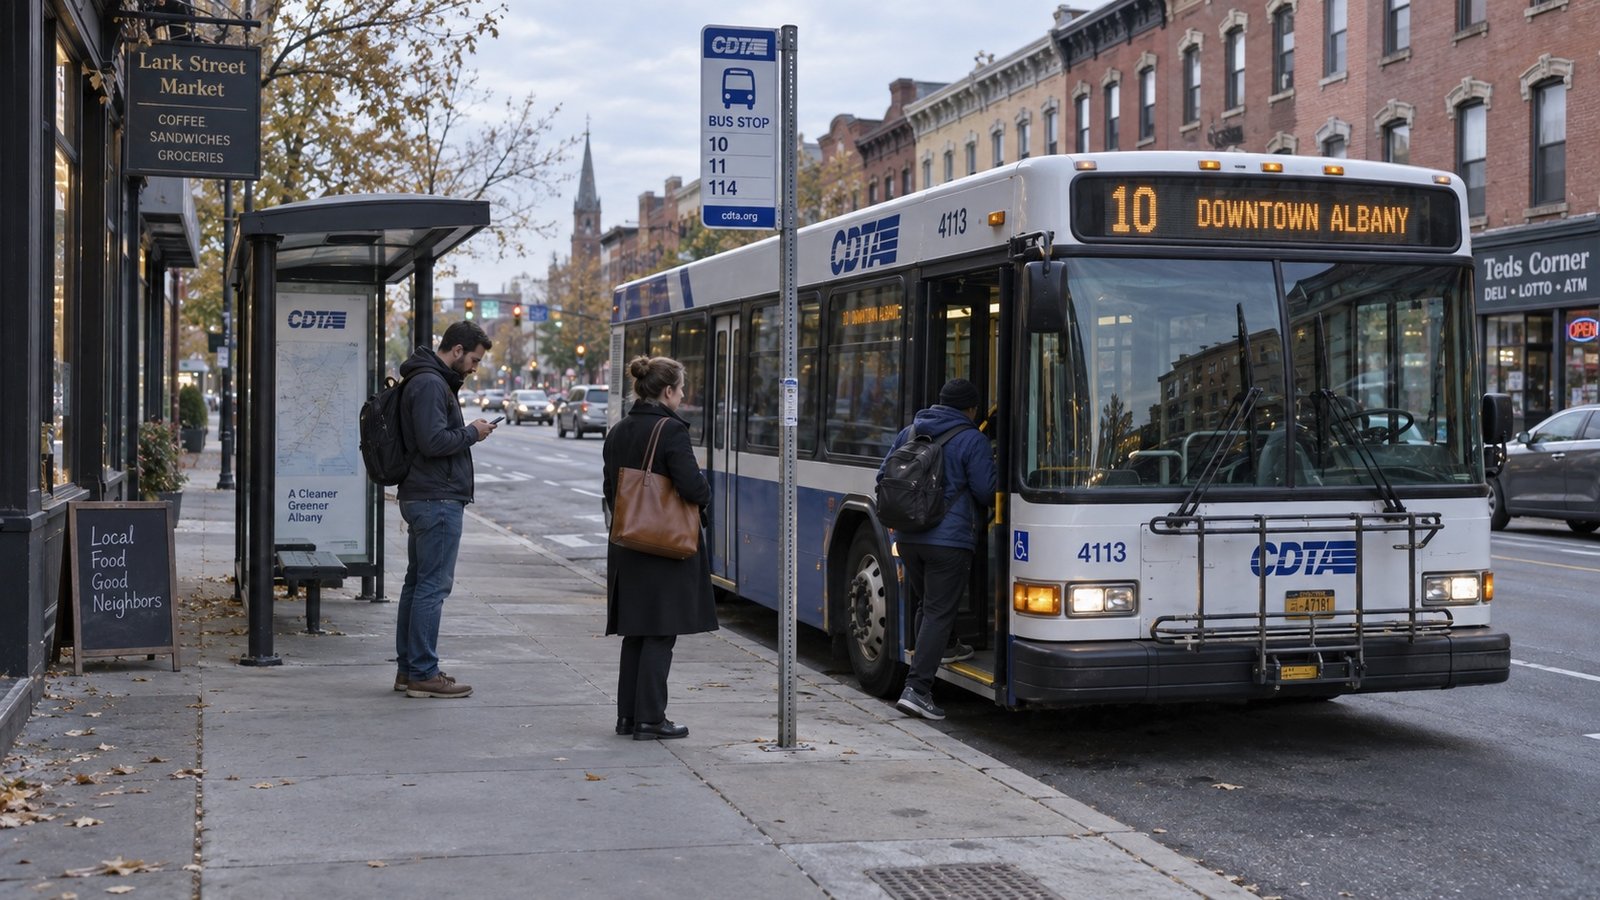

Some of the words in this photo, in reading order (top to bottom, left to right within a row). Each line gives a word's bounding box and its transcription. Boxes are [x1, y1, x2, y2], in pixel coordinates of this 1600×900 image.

[711, 35, 768, 56] CDTA
[139, 52, 183, 71] Lark
[189, 55, 247, 75] Street
[160, 77, 225, 97] Market
[158, 114, 206, 127] COFFEE
[708, 115, 734, 128] BUS
[737, 116, 770, 129] STOP
[150, 131, 231, 146] SANDWICHES
[708, 136, 729, 152] 10
[158, 150, 224, 163] GROCERIES
[708, 158, 726, 174] 11
[708, 179, 738, 196] 114
[721, 211, 758, 222] cdta.org
[1112, 185, 1157, 233] 10
[1197, 198, 1319, 231] DOWNTOWN
[1330, 204, 1409, 234] ALBANY
[937, 207, 967, 239] 4113
[831, 213, 901, 276] CDTA
[1483, 254, 1524, 281] Teds
[1528, 251, 1590, 275] Corner
[1484, 285, 1507, 301] DELI
[1519, 281, 1552, 297] LOTTO
[1563, 277, 1588, 293] ATM
[287, 309, 347, 330] CDTA
[1569, 321, 1596, 338] OPEN
[288, 489, 296, 499] A
[298, 488, 338, 499] Cleaner
[288, 500, 329, 511] Greener
[288, 512, 323, 524] Albany
[91, 524, 135, 546] Local
[92, 549, 126, 568] Food
[1077, 541, 1127, 563] 4113
[1250, 540, 1357, 577] CDTA
[91, 570, 128, 591] Good
[93, 590, 162, 619] Neighbors
